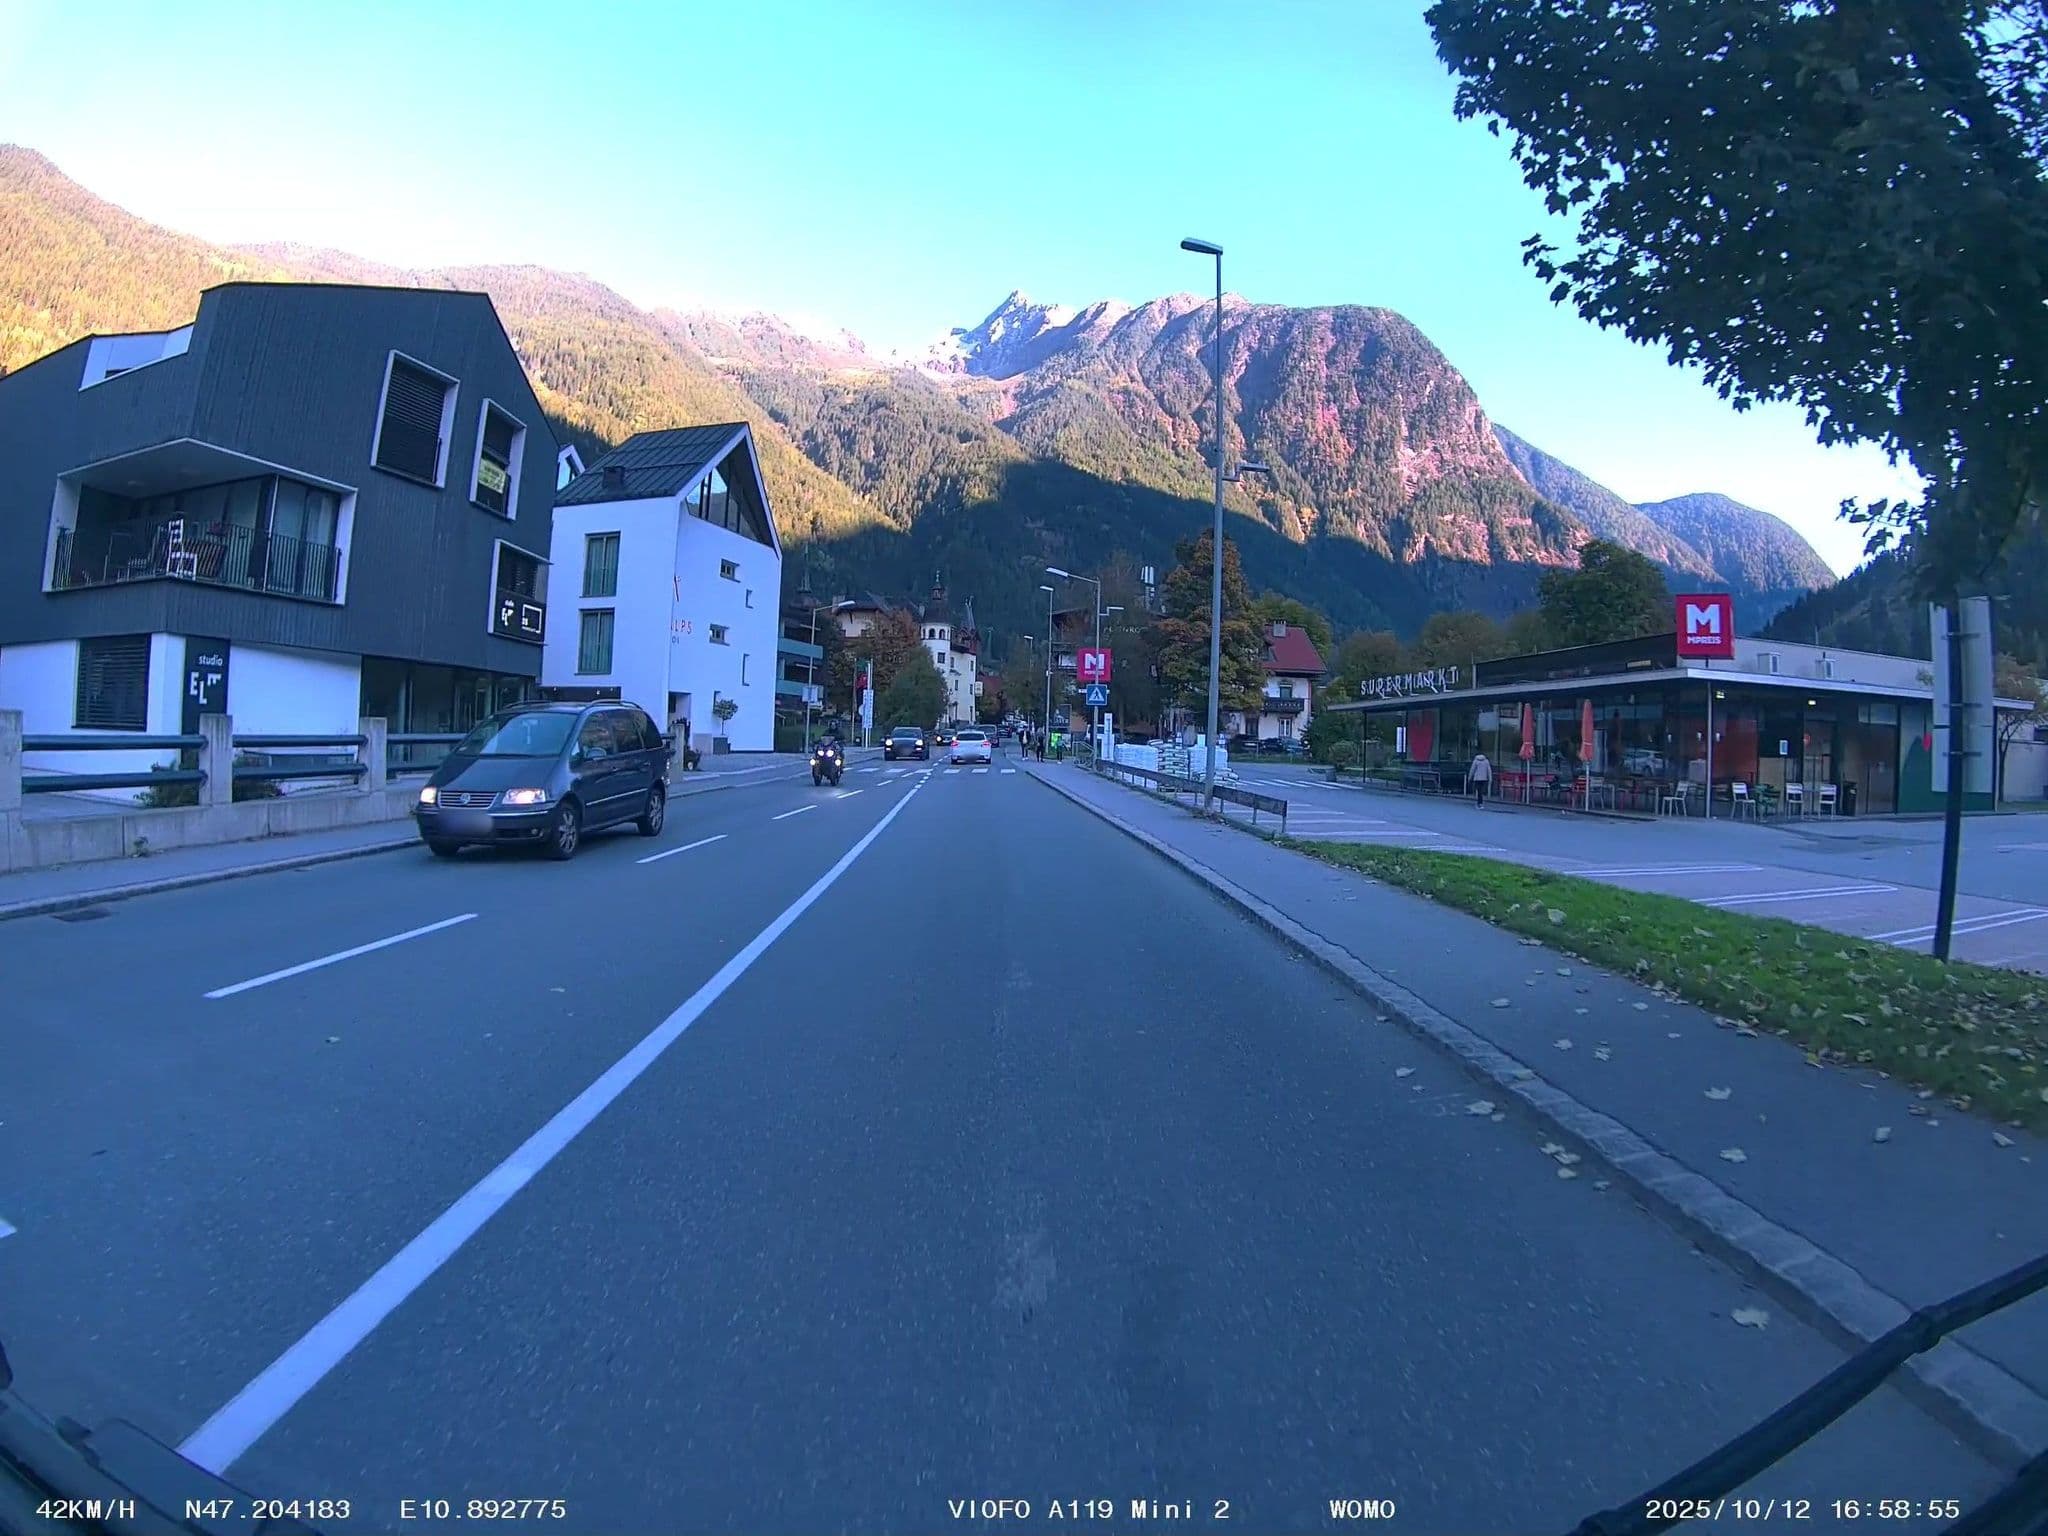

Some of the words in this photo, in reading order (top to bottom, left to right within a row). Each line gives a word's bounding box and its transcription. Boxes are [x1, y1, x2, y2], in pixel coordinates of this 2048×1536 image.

[1686, 604, 1720, 634] M
[1687, 636, 1722, 644] MPREIS
[199, 654, 223, 666] studio
[1084, 653, 1105, 670] M
